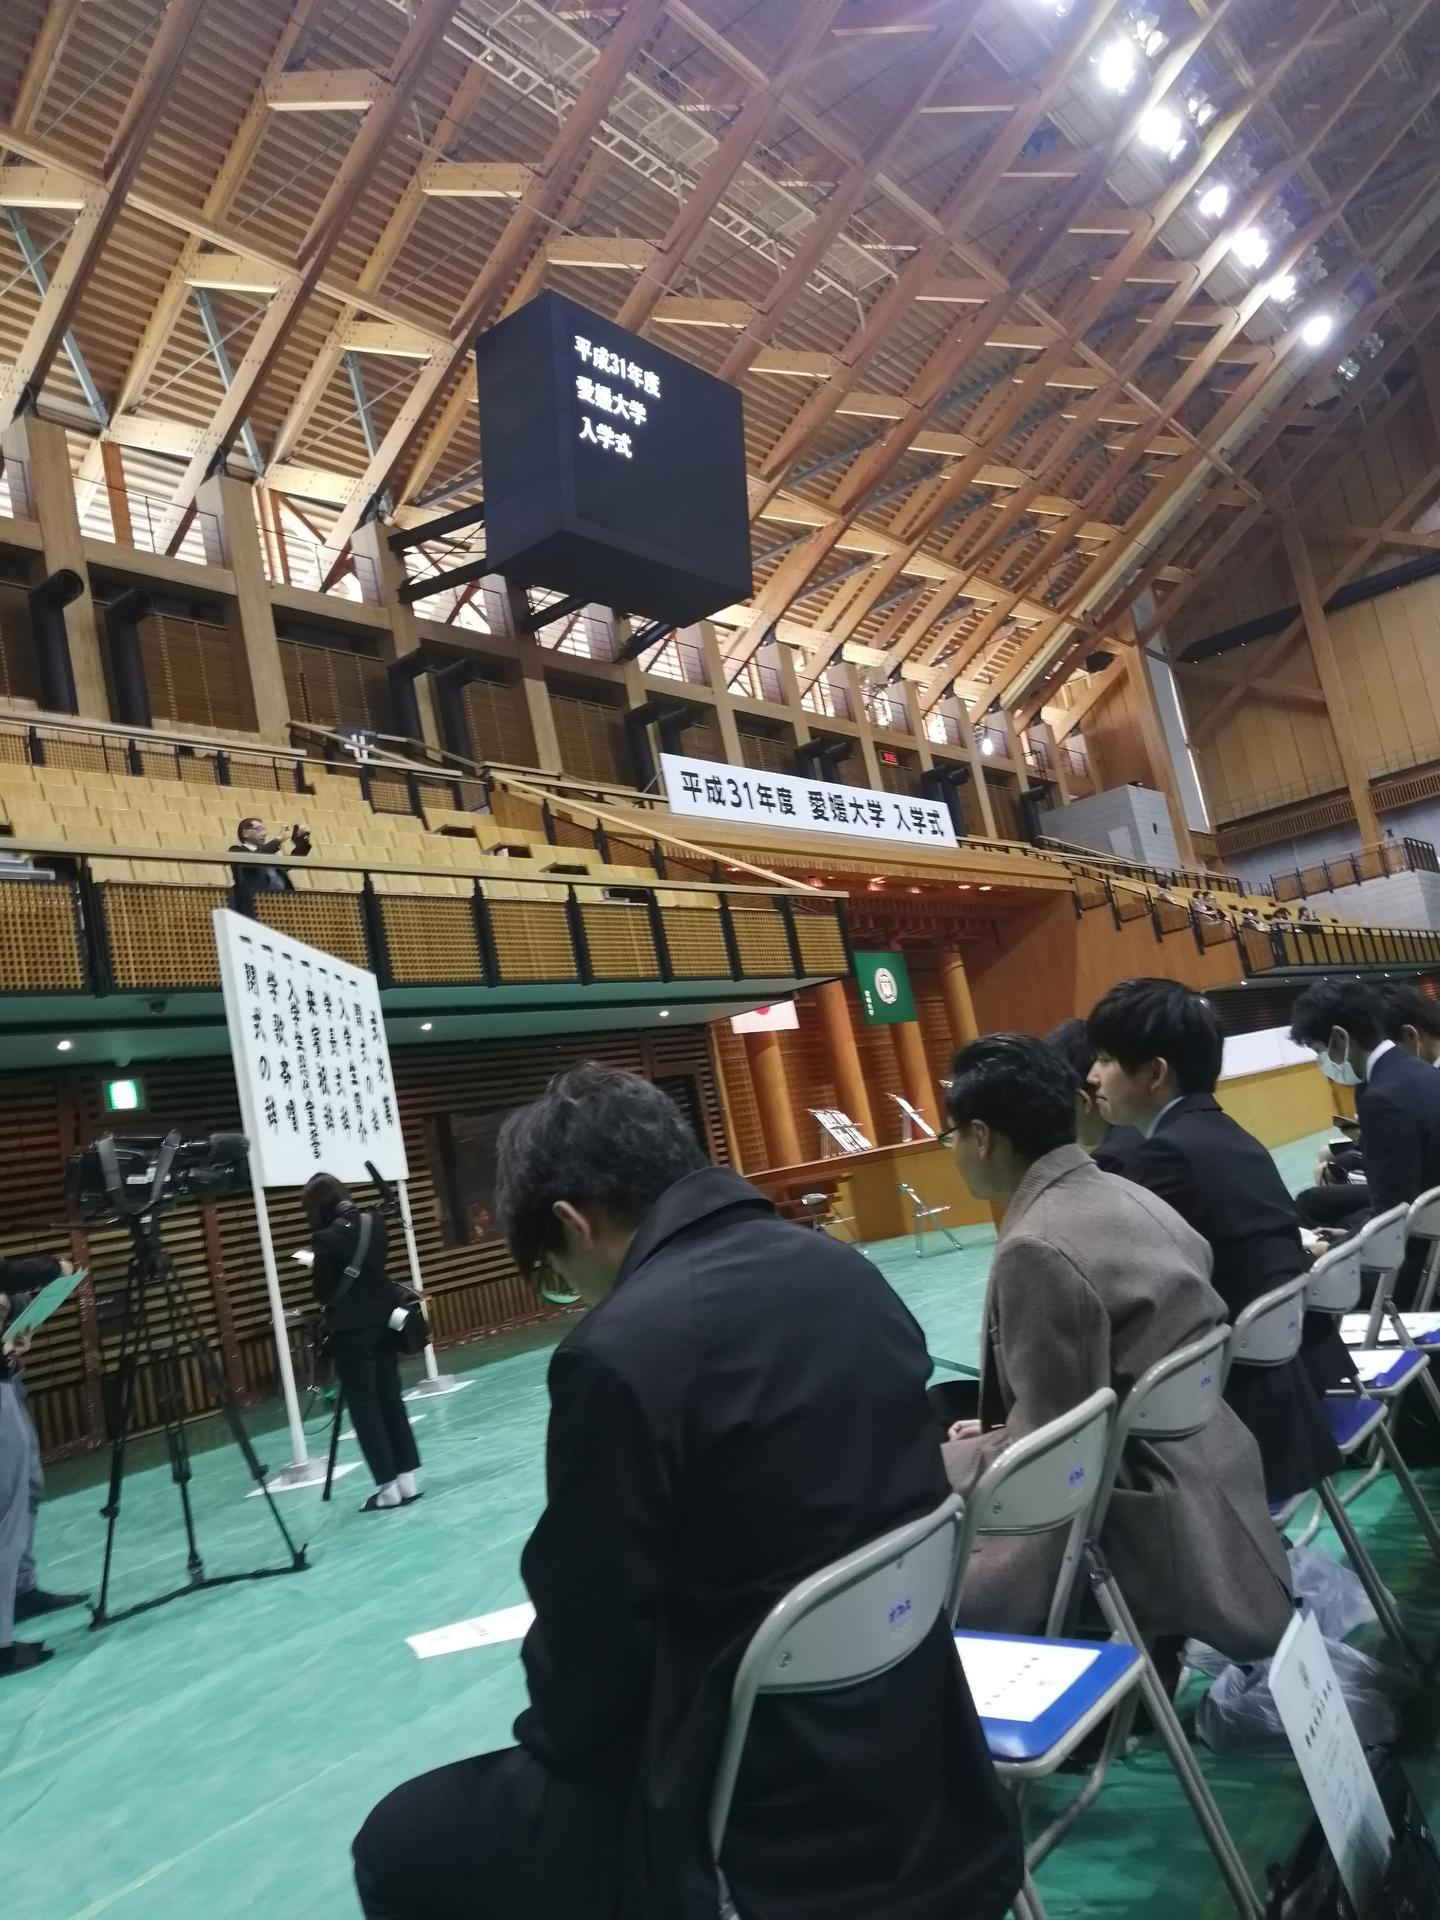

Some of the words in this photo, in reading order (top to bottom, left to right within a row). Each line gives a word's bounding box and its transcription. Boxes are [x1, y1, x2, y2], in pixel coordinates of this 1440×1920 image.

[574, 335, 661, 398] 平成31年度
[576, 376, 647, 425] 愛媛大学
[579, 416, 632, 459] 入学式
[680, 770, 796, 816] 平成31年度
[808, 790, 885, 829] 愛媛大学
[894, 804, 945, 837] 入学式
